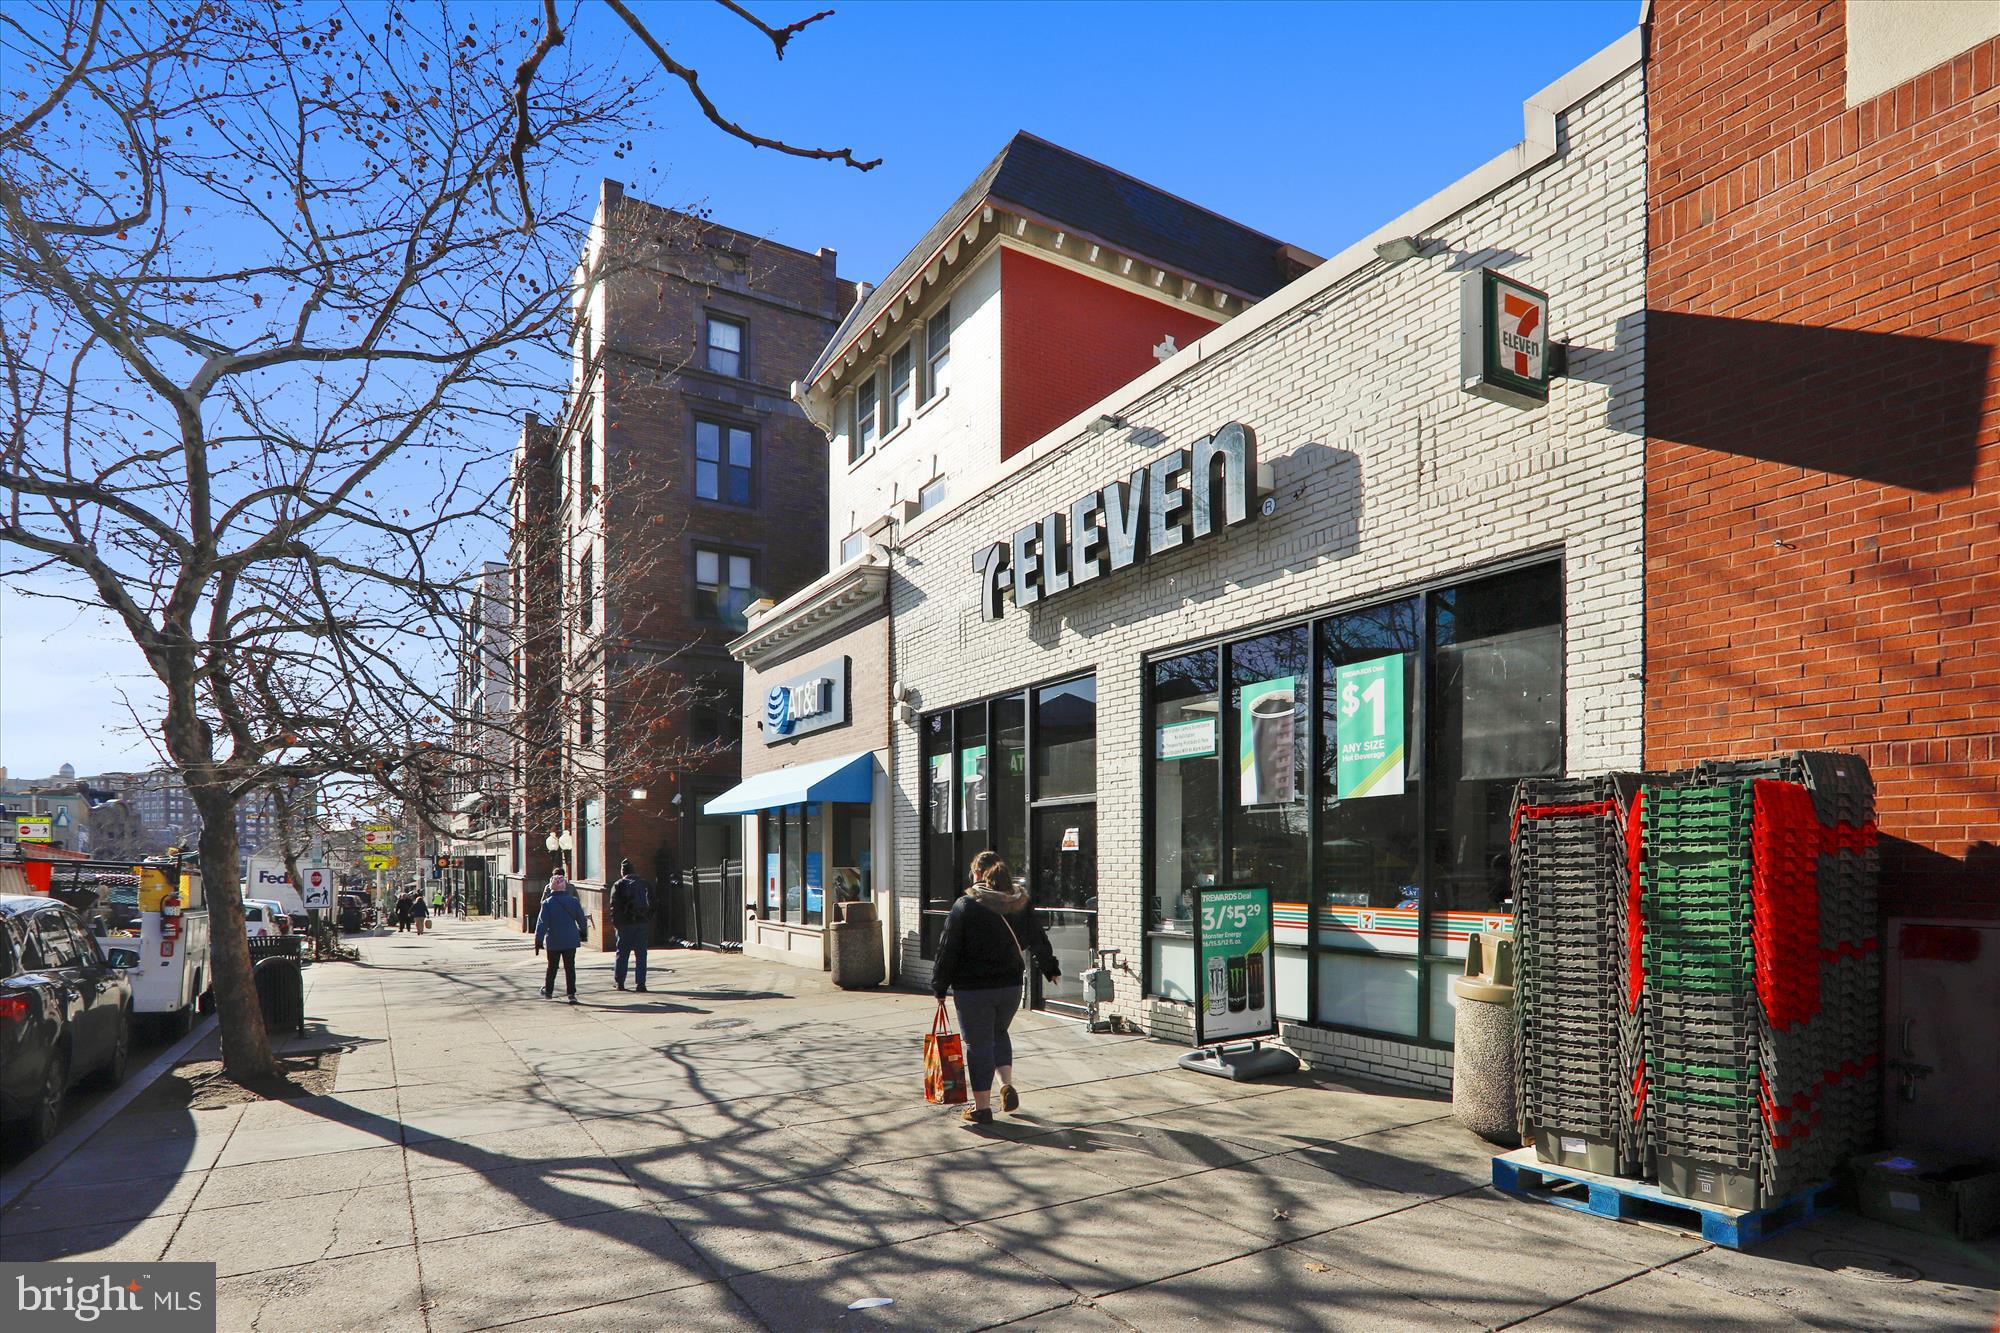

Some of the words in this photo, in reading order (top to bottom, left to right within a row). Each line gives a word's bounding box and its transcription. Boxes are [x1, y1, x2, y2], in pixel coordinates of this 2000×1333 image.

[787, 677, 828, 721] AT&T
[1341, 677, 1386, 737] $1
[1342, 742, 1362, 754] ANY
[1363, 739, 1385, 751] SIZE
[1237, 891, 1252, 900] Deal
